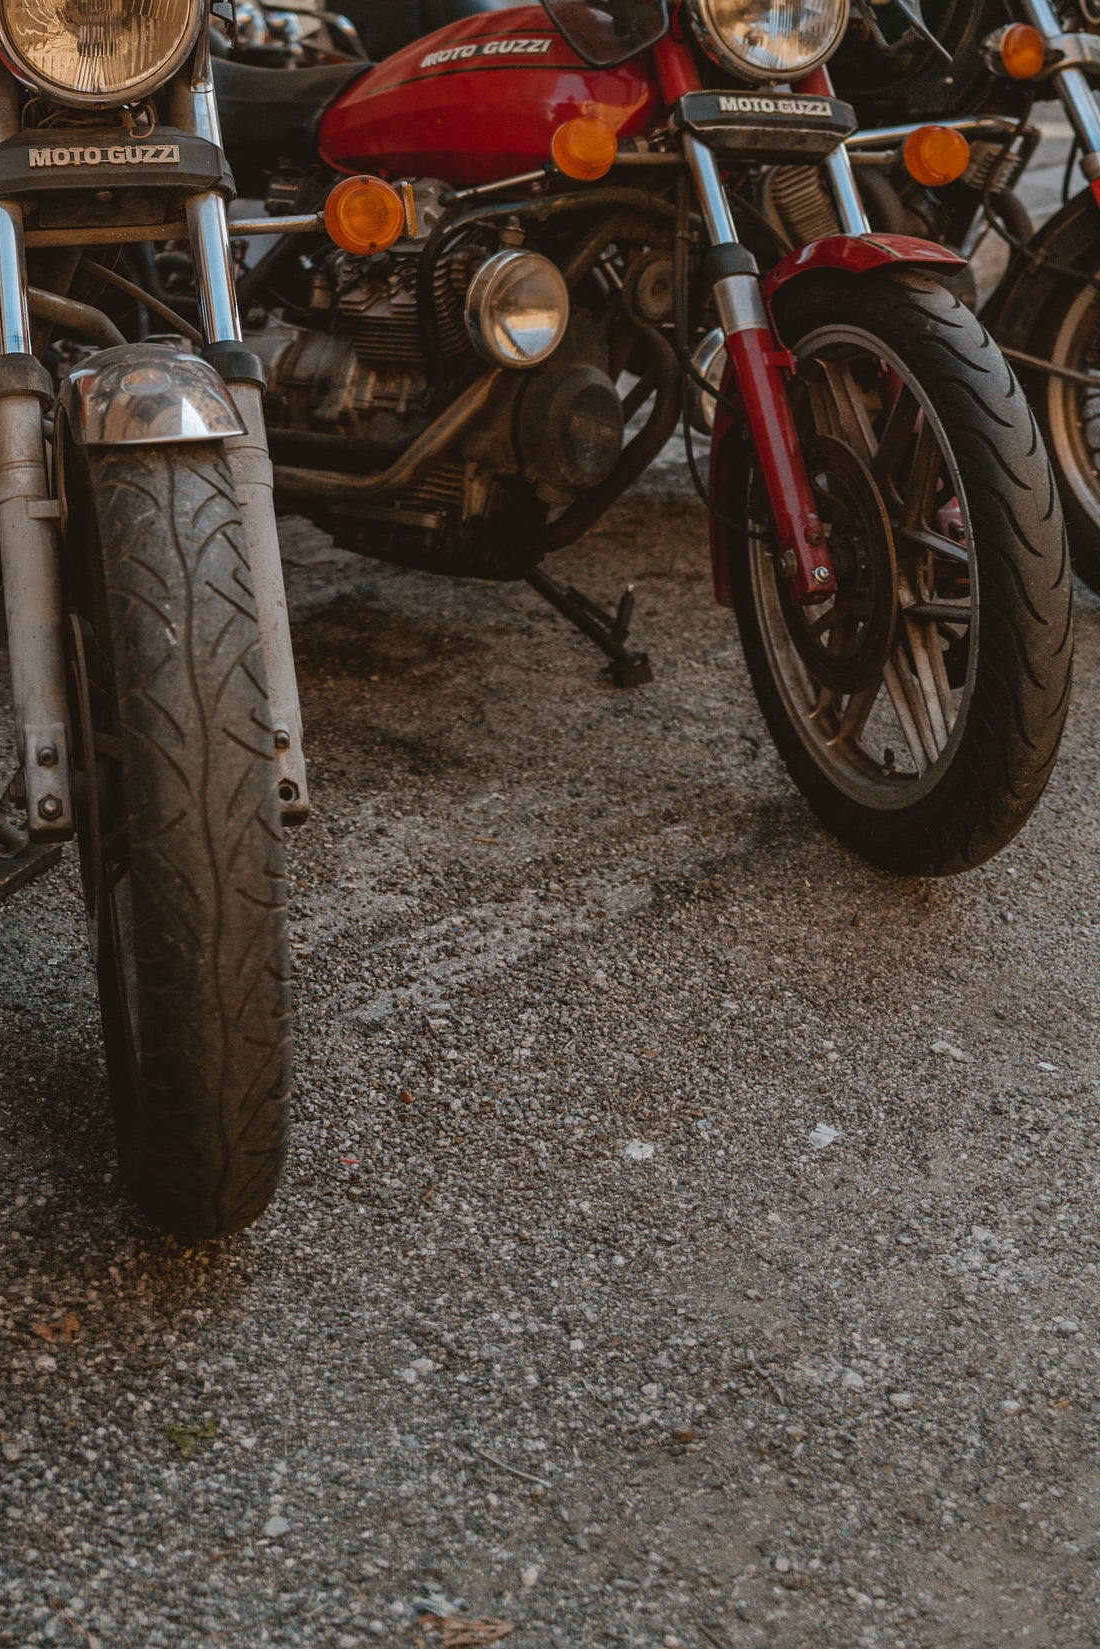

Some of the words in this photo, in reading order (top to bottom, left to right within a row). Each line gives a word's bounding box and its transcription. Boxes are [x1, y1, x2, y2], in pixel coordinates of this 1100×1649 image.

[420, 44, 479, 68] MOTO
[482, 38, 552, 55] GUZZI
[719, 96, 776, 113] MOTO
[779, 100, 833, 117] GUZZI
[29, 146, 100, 168] MOTO
[108, 144, 180, 166] GUZZI
